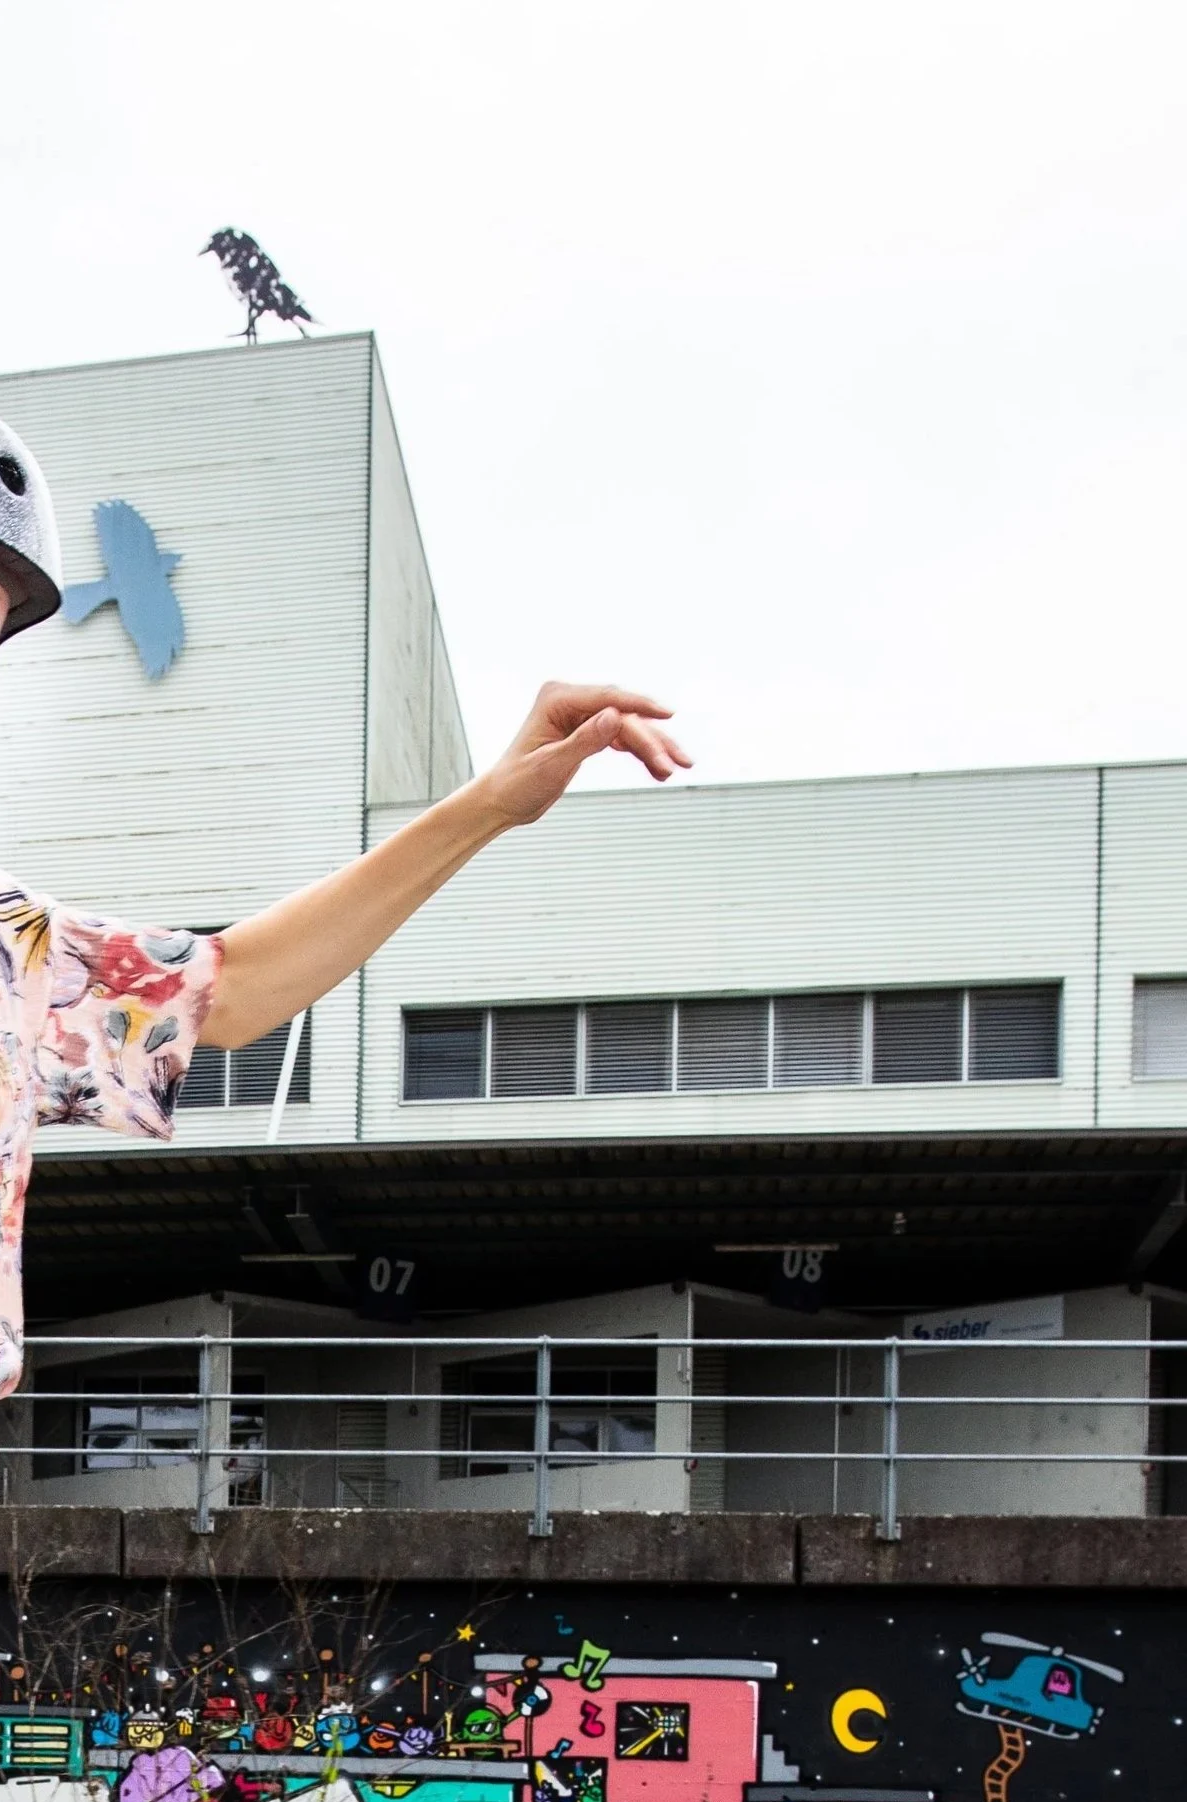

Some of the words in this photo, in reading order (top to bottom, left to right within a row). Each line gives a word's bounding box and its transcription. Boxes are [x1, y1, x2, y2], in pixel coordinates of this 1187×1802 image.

[369, 1256, 416, 1296] 07
[783, 1247, 823, 1283] 08
[933, 1318, 993, 1341] sieber
